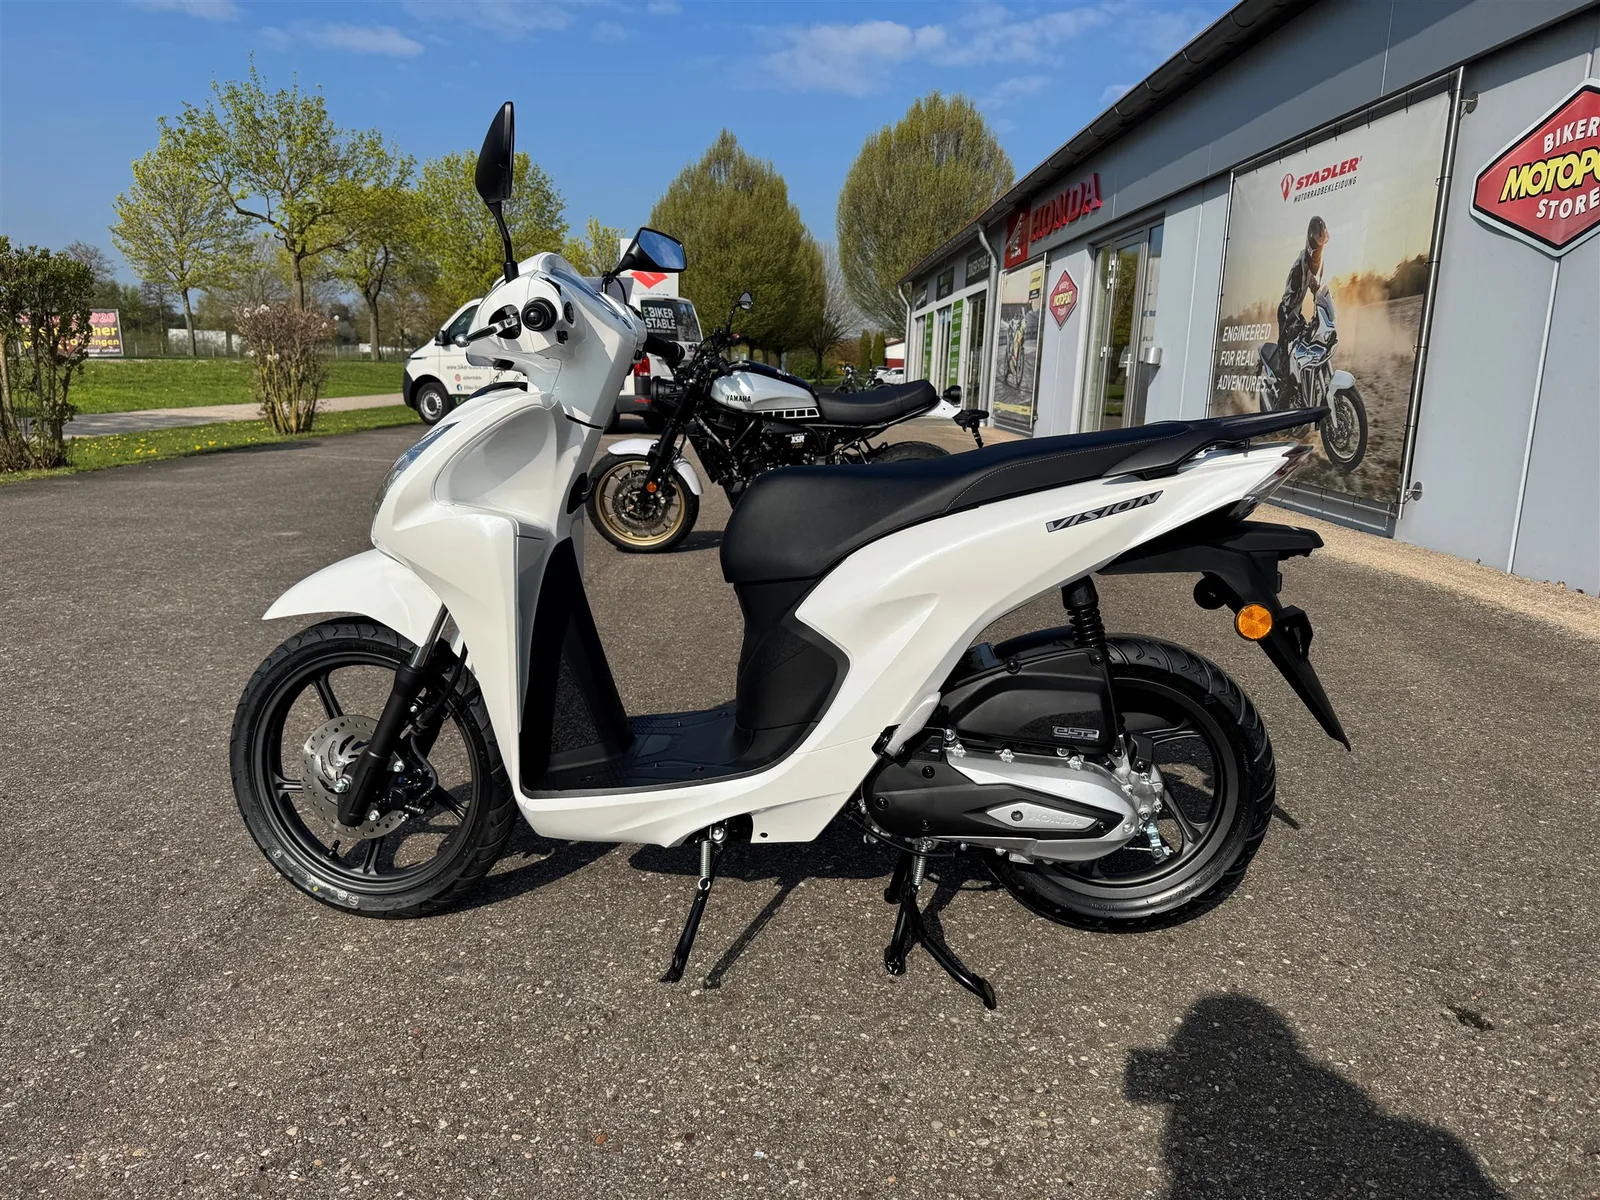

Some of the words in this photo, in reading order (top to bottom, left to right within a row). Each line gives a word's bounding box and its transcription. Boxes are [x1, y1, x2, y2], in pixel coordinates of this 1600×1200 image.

[1543, 116, 1600, 154] BIKER
[1293, 175, 1357, 203] MOTORRADBEKLEIDUNG
[1295, 157, 1359, 191] STADLER
[1030, 172, 1102, 242] HONDA
[1536, 187, 1600, 220] STORE
[645, 317, 677, 330] STABLE
[1222, 323, 1272, 342] ENGINEERED
[1220, 350, 1236, 366] FOR
[1235, 349, 1255, 366] REAL
[726, 394, 752, 403] YAMAHA
[1047, 491, 1162, 531] VISION
